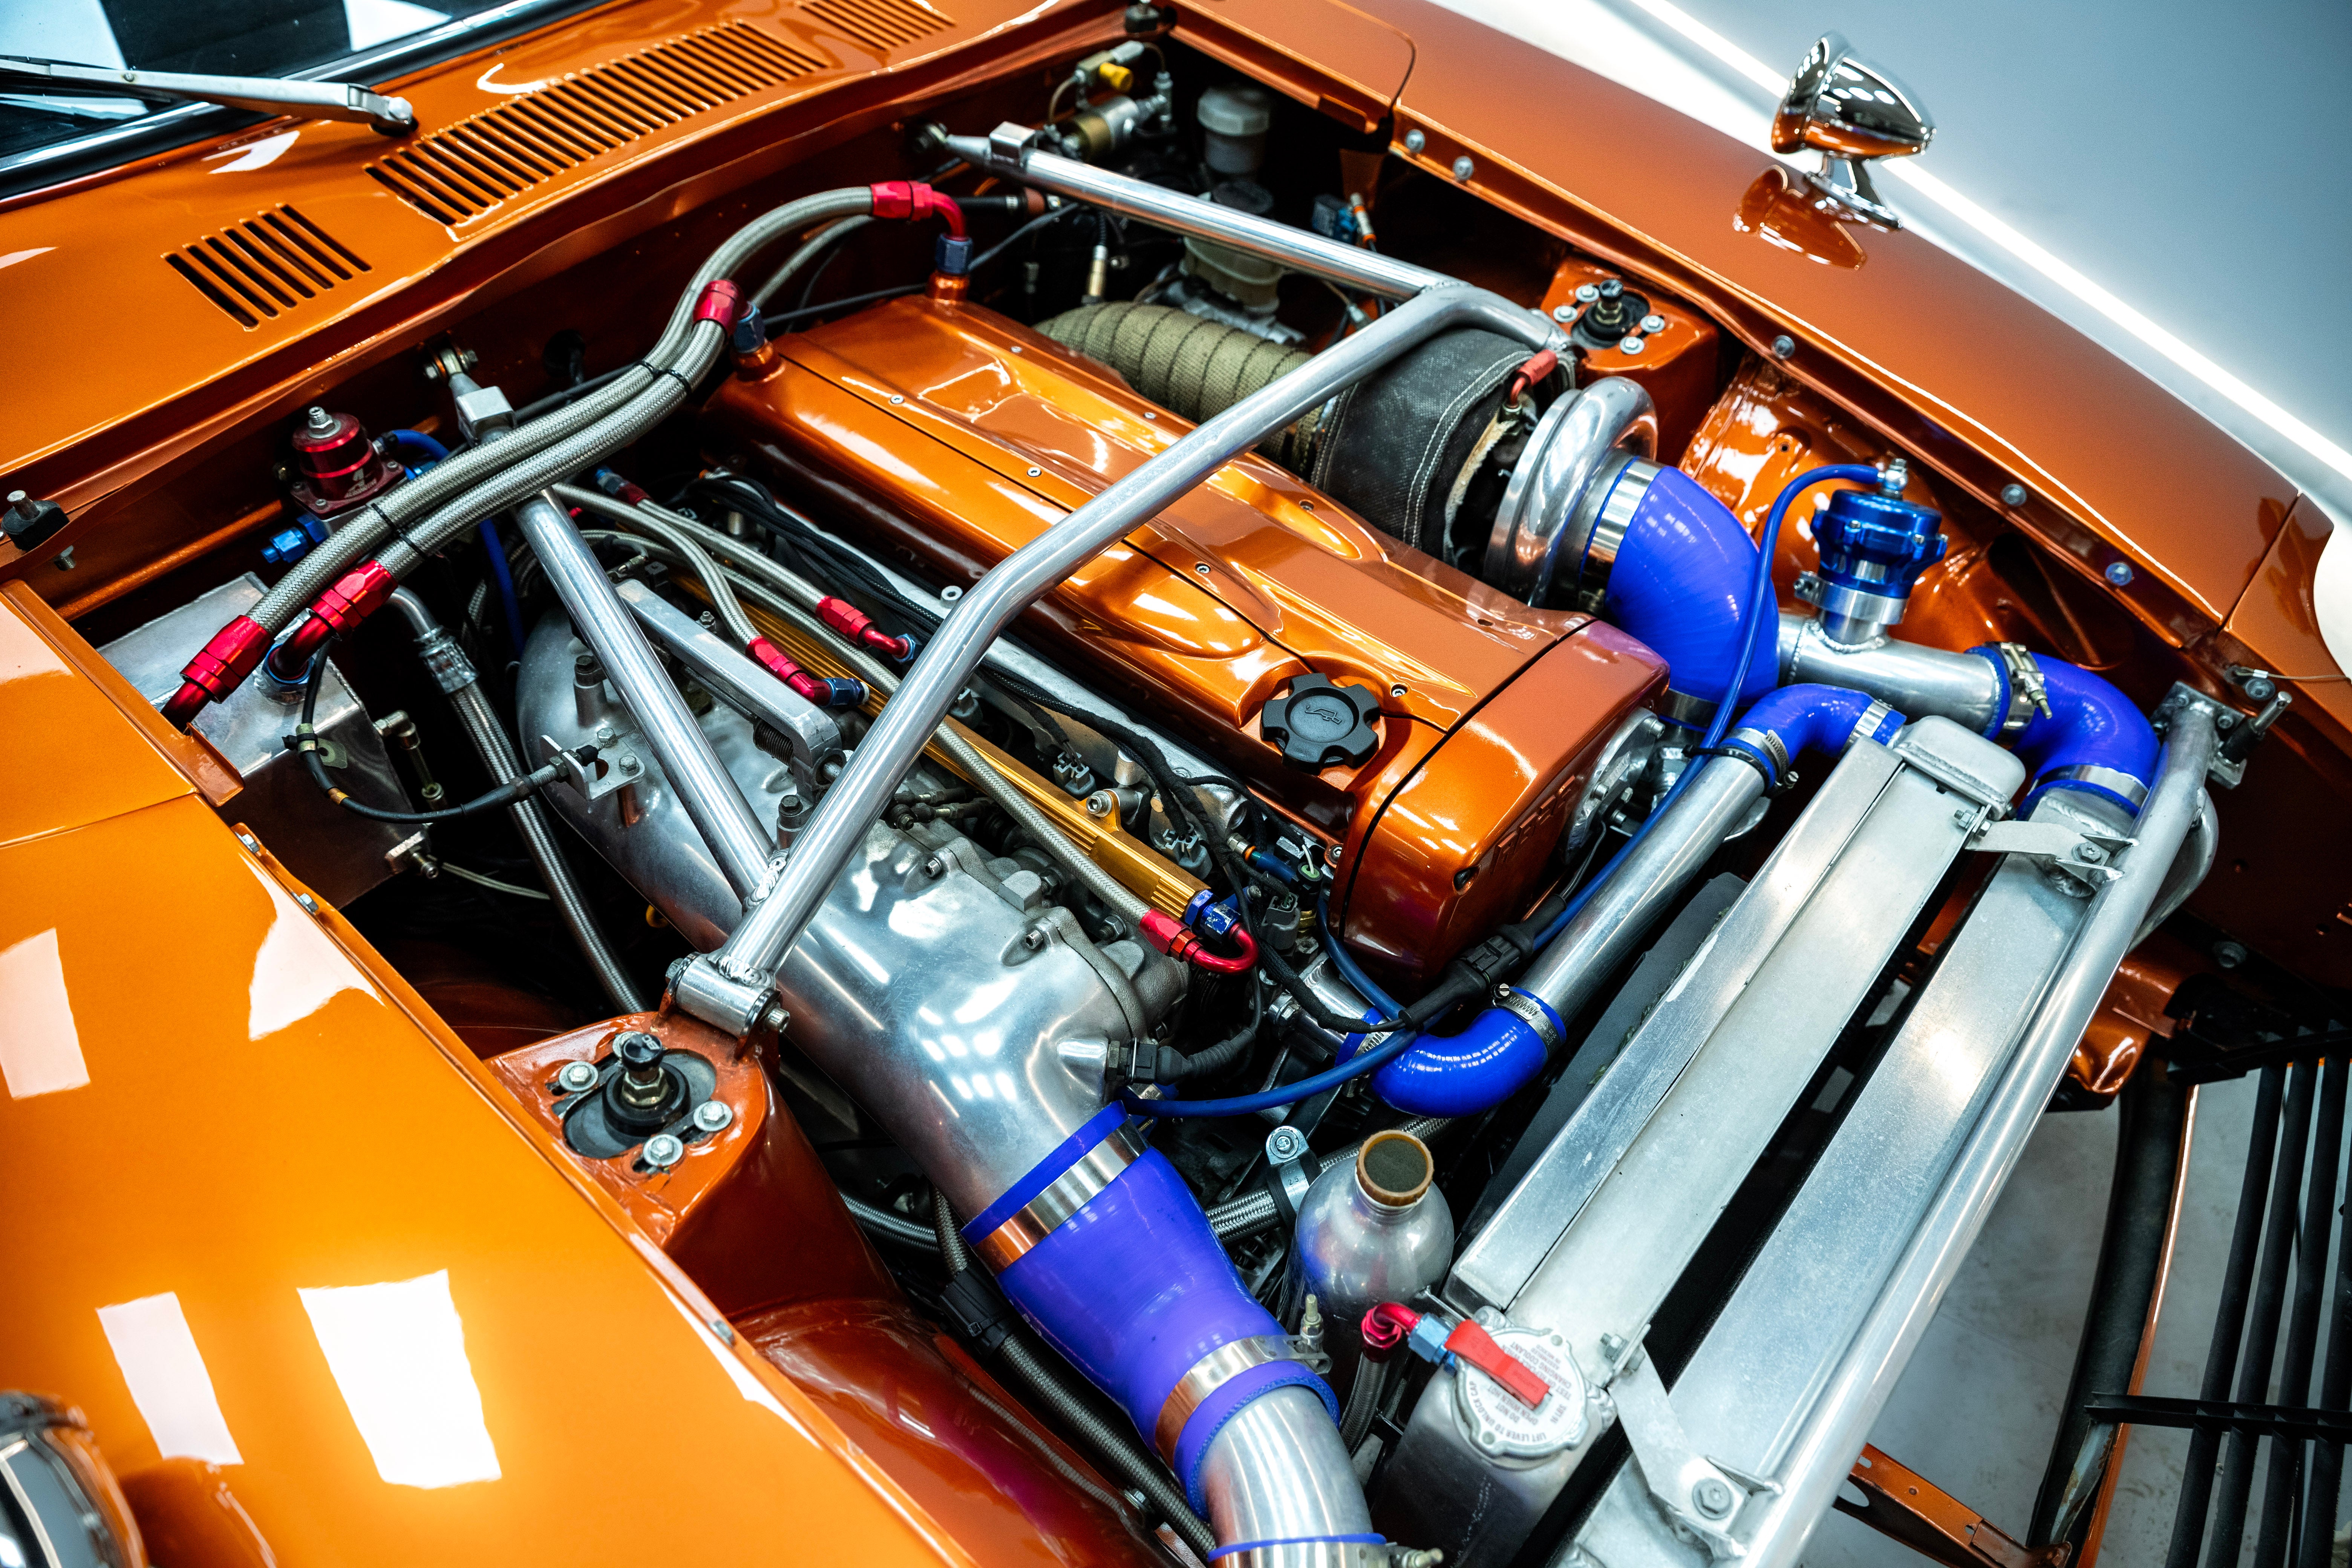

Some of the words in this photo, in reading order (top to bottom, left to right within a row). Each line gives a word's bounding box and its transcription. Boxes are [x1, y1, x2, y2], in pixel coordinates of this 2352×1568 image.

[1510, 1341, 1539, 1364] COOLANT
[1531, 1348, 1559, 1370] ASSEMBLED
[1536, 1344, 1554, 1359] MEXICO
[1538, 1362, 1572, 1389] CHANGING
[1469, 1381, 1478, 1396] CAP
[1488, 1385, 1501, 1396] HOT
[1556, 1386, 1571, 1400] TEST
[1495, 1403, 1508, 1416] NOT
[1502, 1394, 1520, 1412] WHEN
[1473, 1398, 1495, 1426] UNLOCK
[1509, 1412, 1520, 1423] DO
[1521, 1410, 1539, 1425] OPEN
[1495, 1423, 1505, 1435] TO
[1506, 1431, 1530, 1441] LEVER
[1532, 1433, 1547, 1441] LIFT
